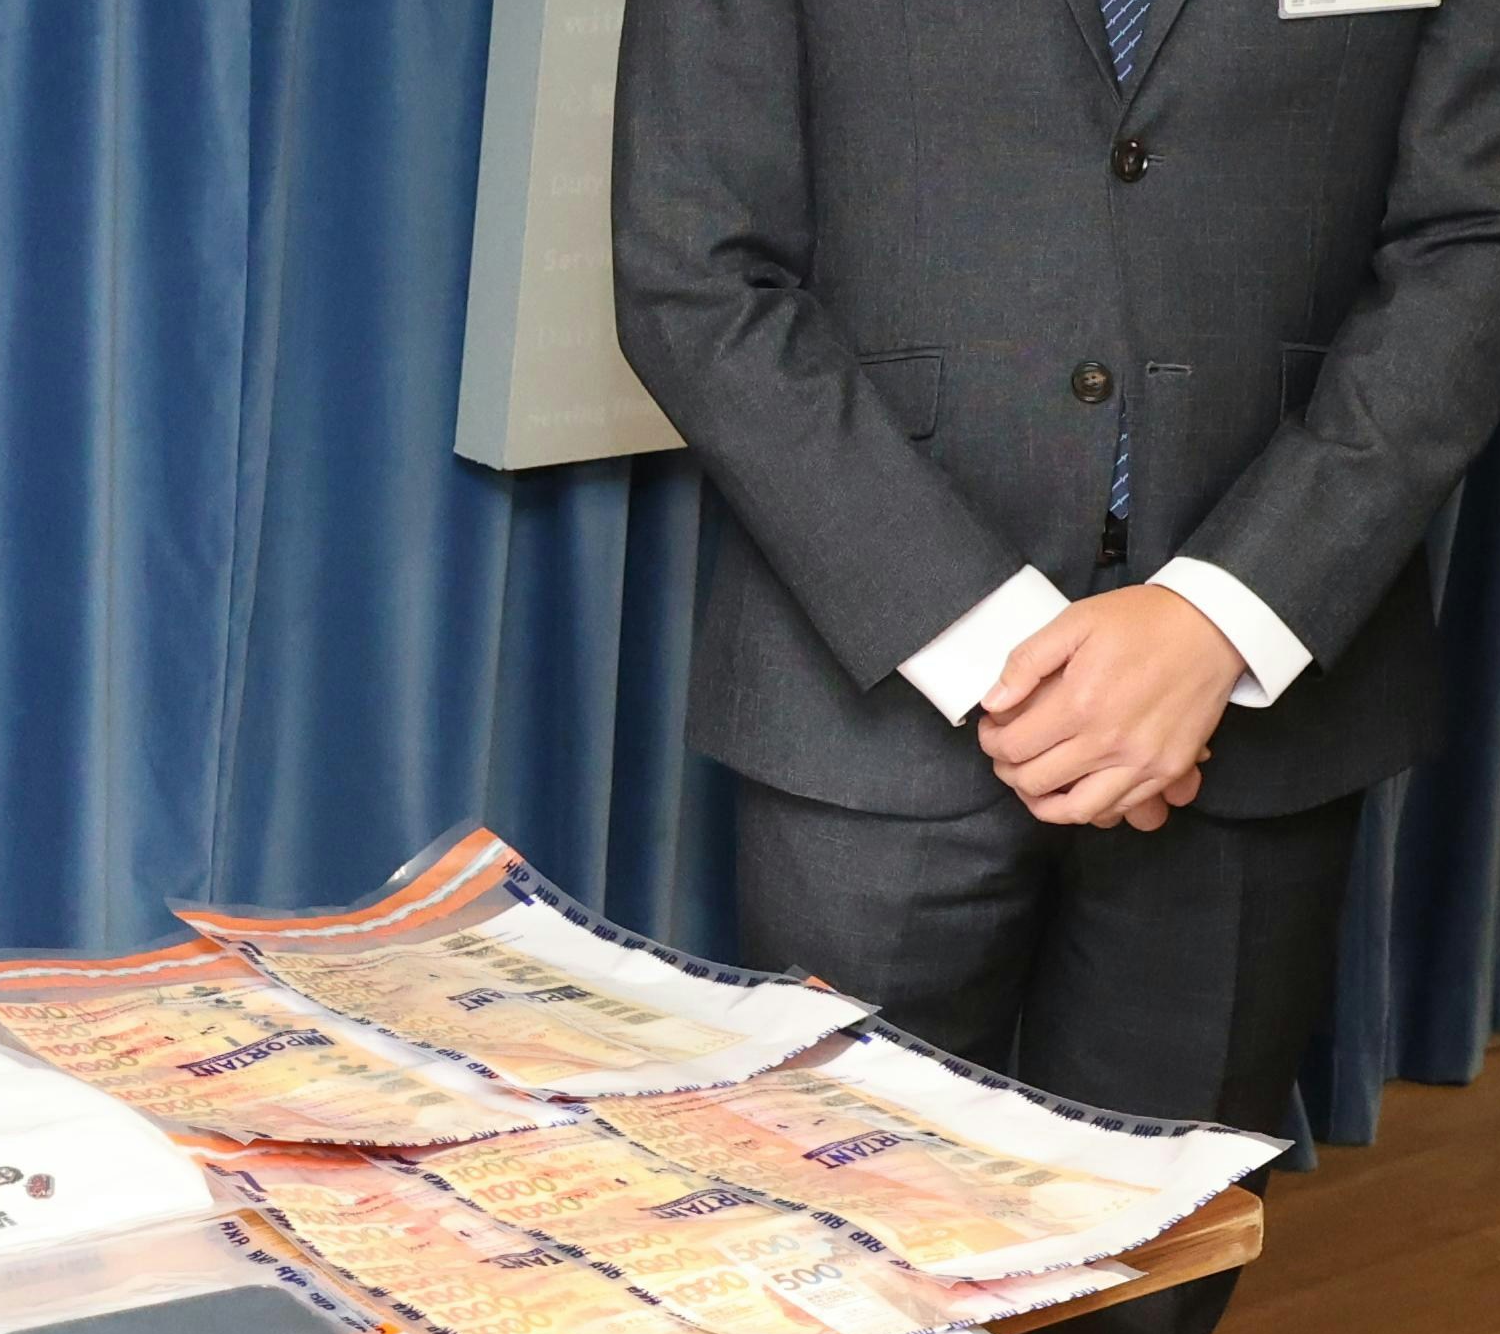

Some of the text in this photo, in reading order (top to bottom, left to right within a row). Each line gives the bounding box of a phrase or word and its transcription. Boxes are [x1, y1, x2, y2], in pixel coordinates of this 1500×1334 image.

[503, 859, 530, 884] HKP
[187, 1032, 336, 1077] IMPORTANT
[472, 1175, 557, 1204] 1000
[495, 1196, 584, 1221] 1000
[729, 1234, 800, 1262] 500
[772, 1263, 842, 1291] 500
[434, 1295, 524, 1325] 1000
